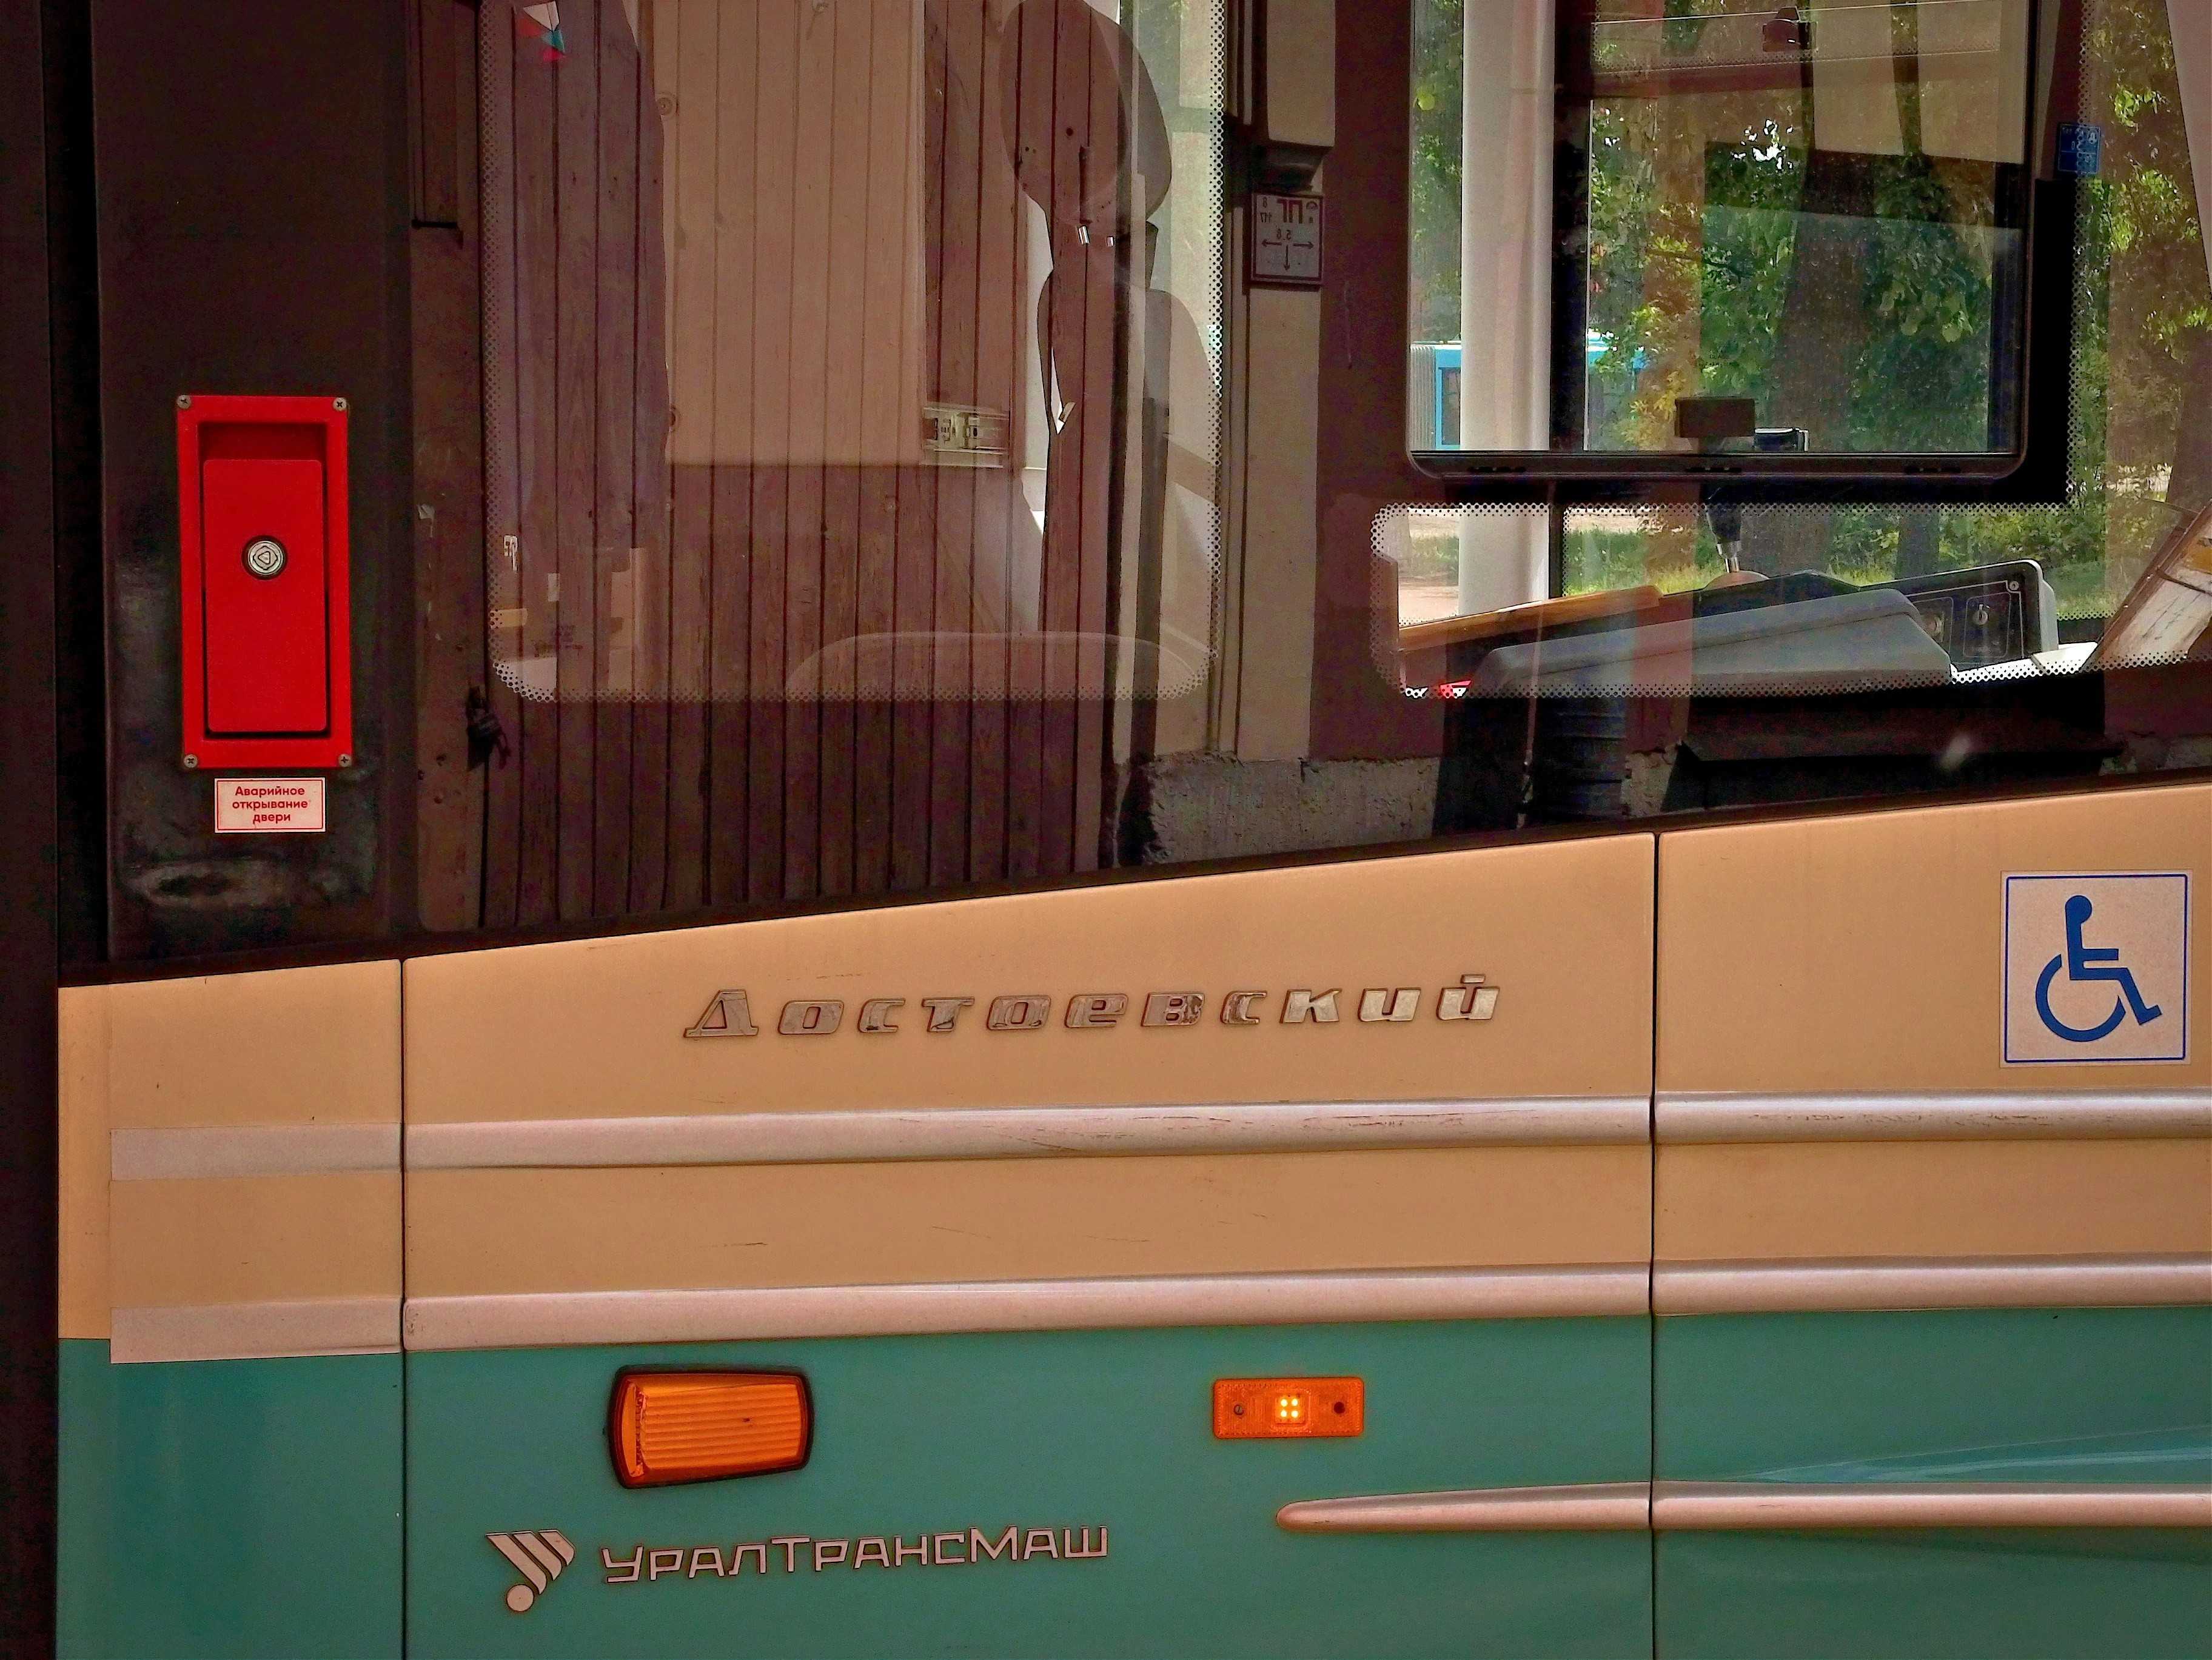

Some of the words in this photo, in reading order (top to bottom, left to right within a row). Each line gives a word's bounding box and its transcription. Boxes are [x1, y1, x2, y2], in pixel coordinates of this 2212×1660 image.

[235, 786, 305, 798] Аварийное
[232, 800, 308, 811] открывание
[253, 814, 290, 824] двери
[683, 974, 1501, 1038] Достоевский
